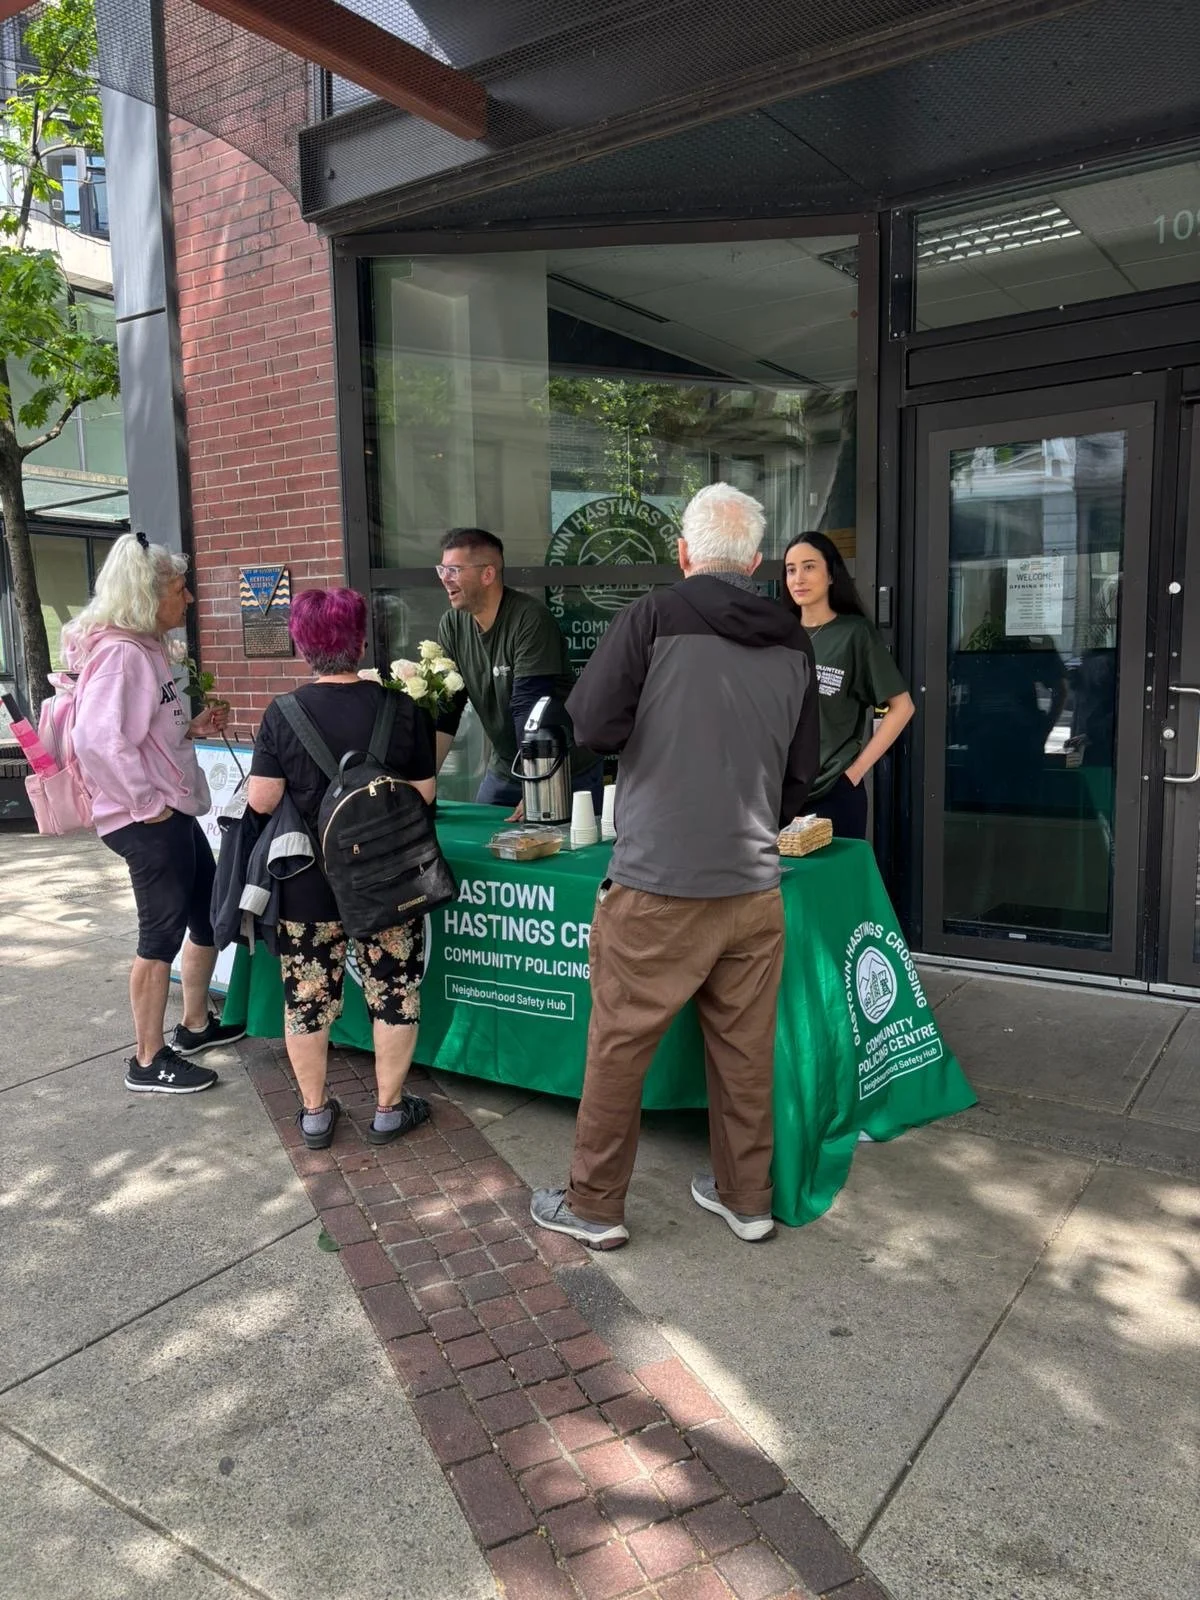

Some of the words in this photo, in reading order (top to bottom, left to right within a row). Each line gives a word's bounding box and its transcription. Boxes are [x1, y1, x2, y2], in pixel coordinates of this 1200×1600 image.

[1153, 208, 1200, 244] 10
[571, 499, 661, 530] HASTINGS
[1016, 572, 1053, 581] WELCOME
[816, 664, 845, 676] OLUNTEER
[457, 879, 555, 912] ASTOWN
[444, 909, 555, 946] HASTINGS
[444, 946, 522, 971] COMMUNITY
[525, 956, 590, 980] POLICING
[846, 921, 884, 959] HASTINGS
[885, 931, 927, 1008] CROSSING
[452, 983, 516, 1004] Neighbourhood
[516, 993, 545, 1010] Safety
[546, 999, 567, 1011] Hub
[859, 1043, 888, 1076] POLICING
[888, 1022, 937, 1052] CENTRE
[898, 1054, 923, 1070] Safety
[922, 1047, 937, 1059] Hub
